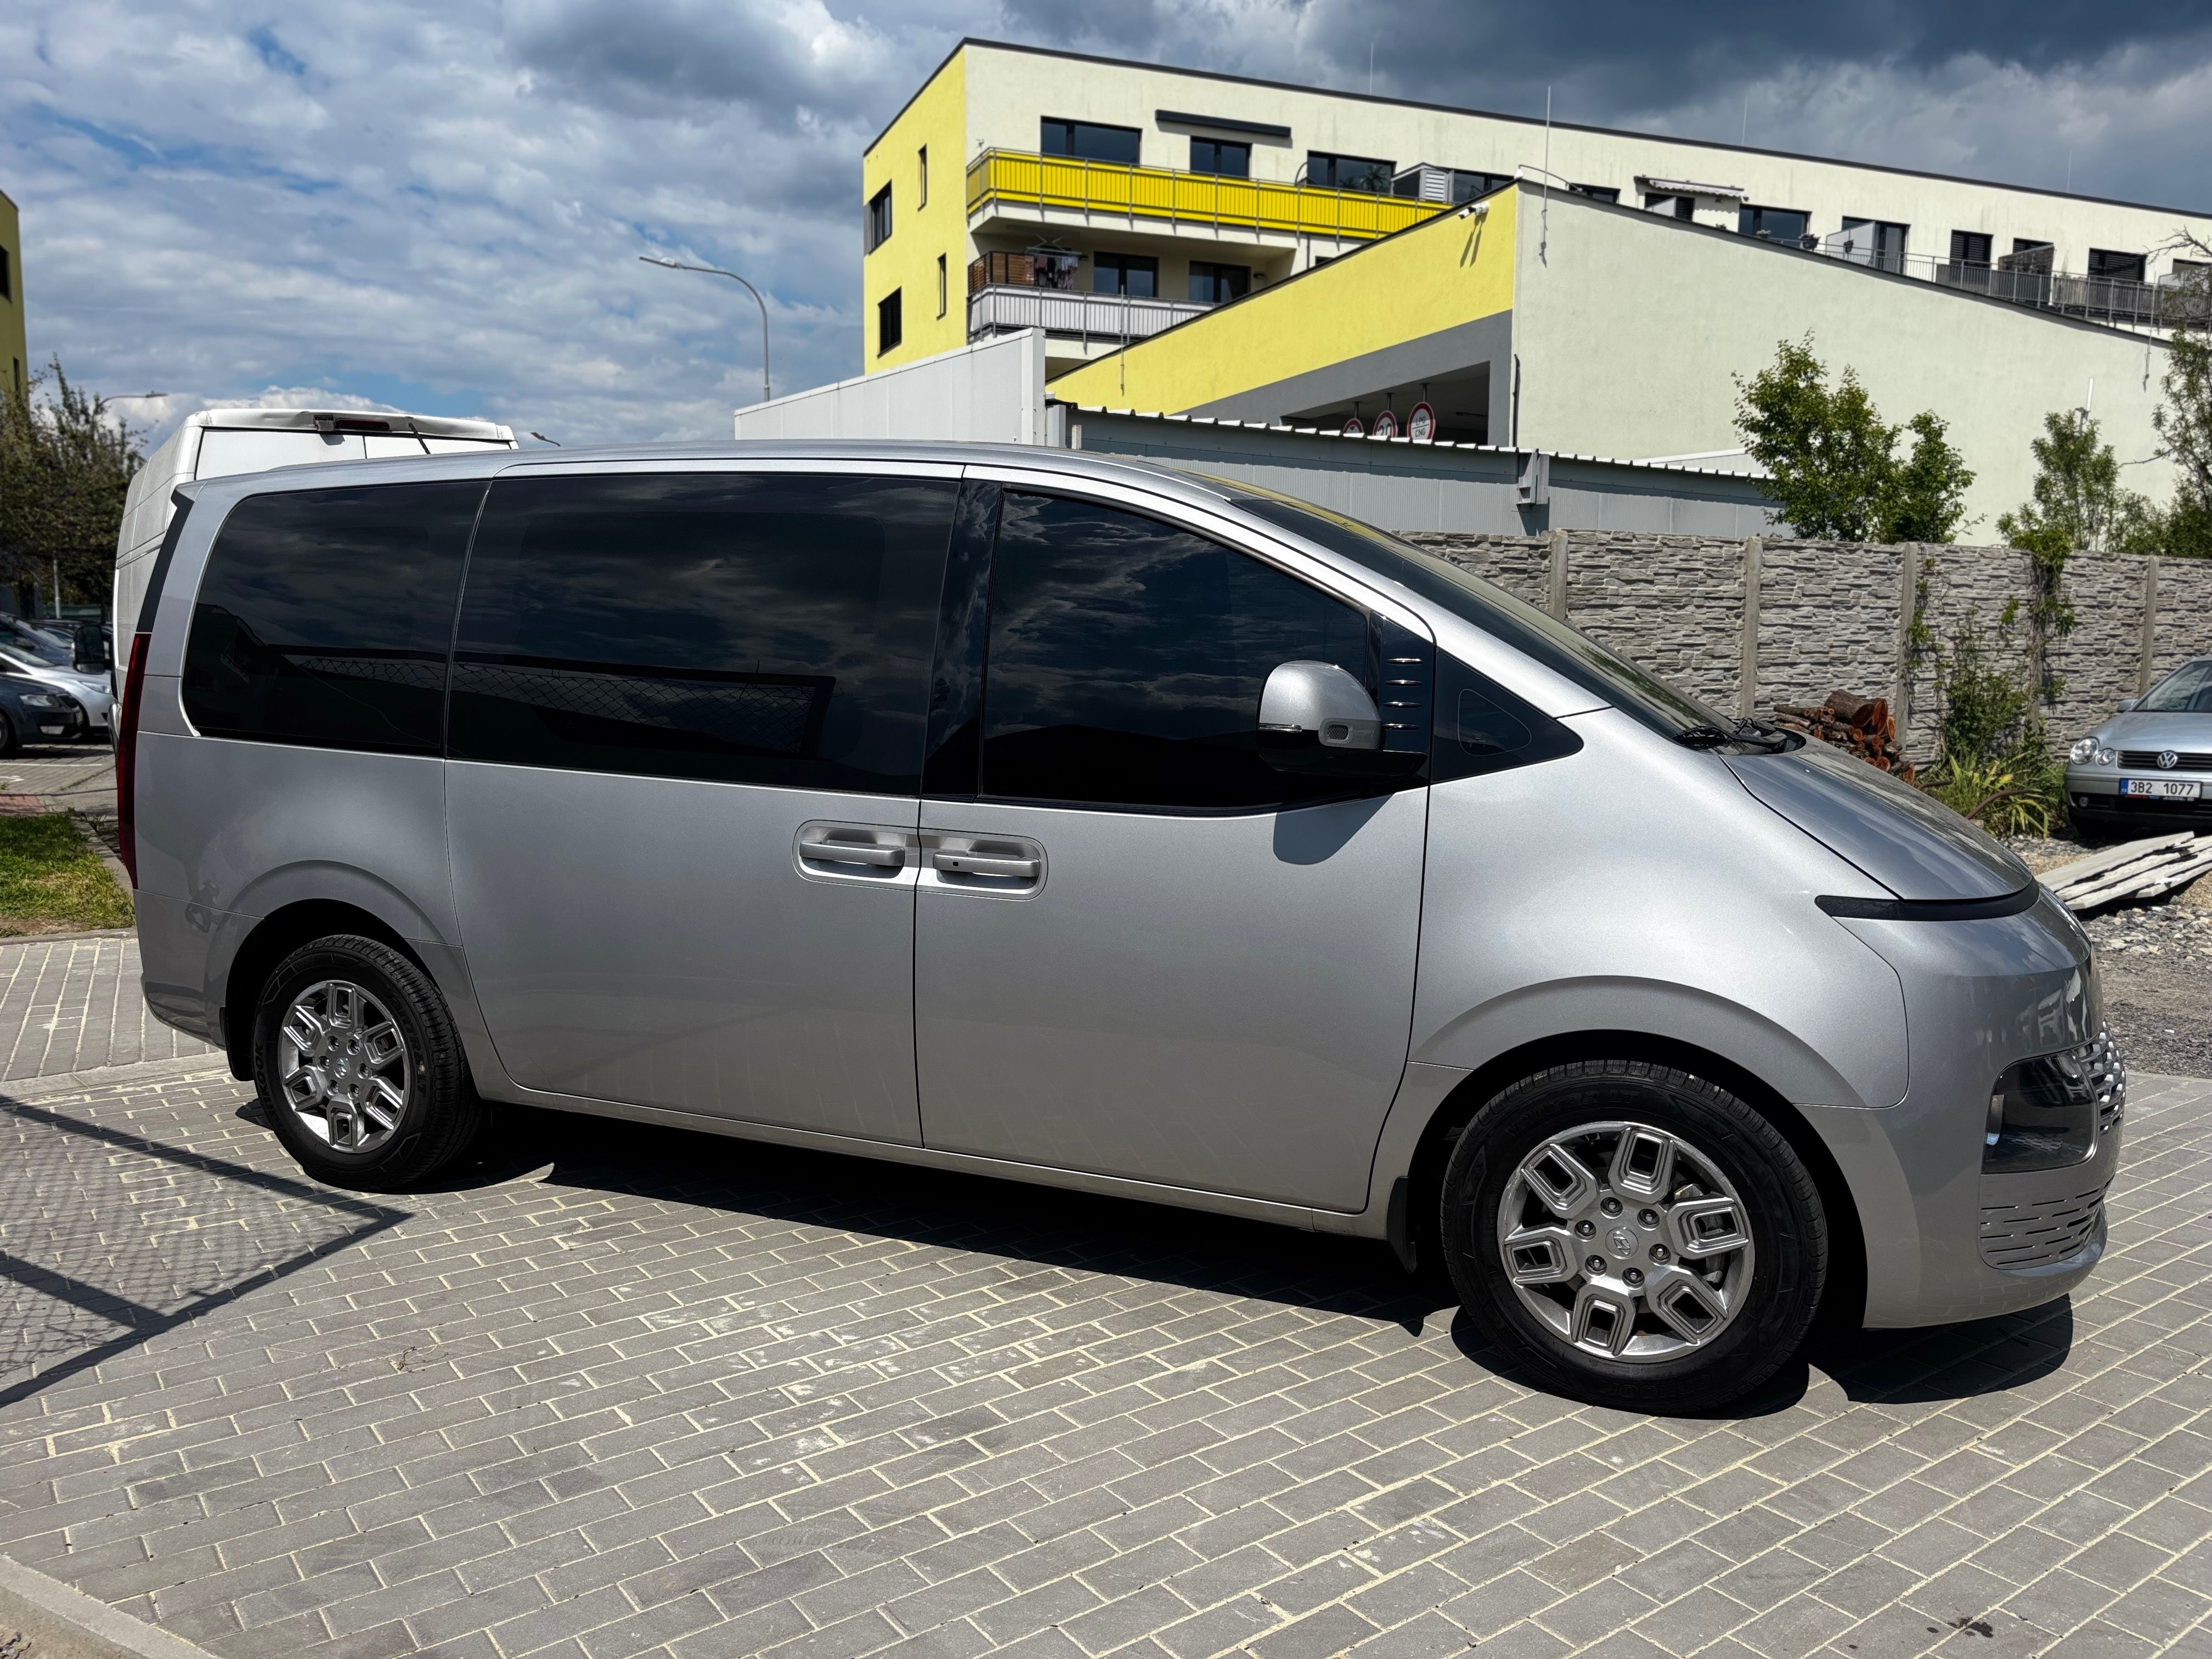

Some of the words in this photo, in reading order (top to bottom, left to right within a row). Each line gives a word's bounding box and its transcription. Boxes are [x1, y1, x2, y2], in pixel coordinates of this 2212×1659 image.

[1415, 416, 1426, 425] LPG
[1378, 423, 1391, 436] 20
[1415, 428, 1426, 437] CNG
[2130, 782, 2152, 794] 3B2
[2163, 783, 2194, 795] 1077
